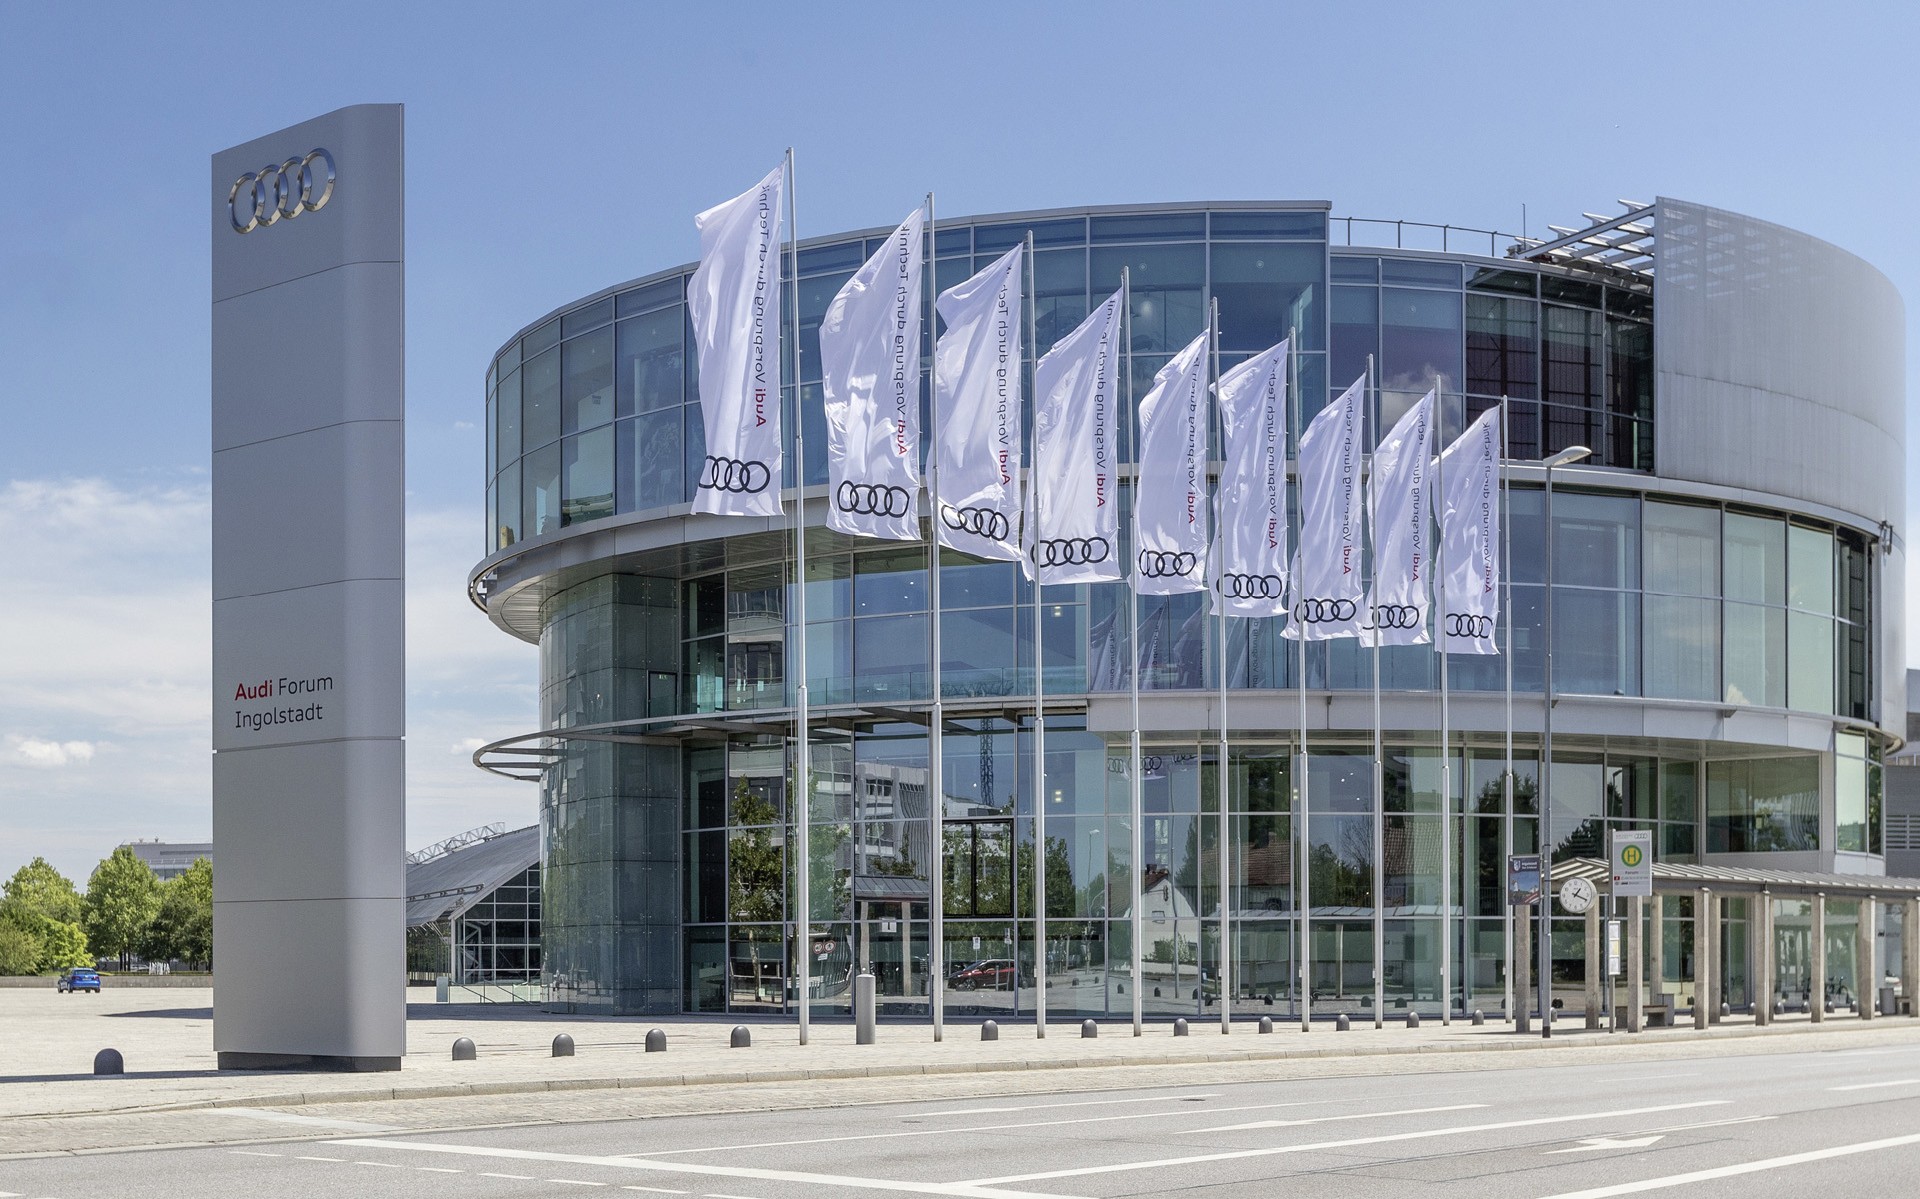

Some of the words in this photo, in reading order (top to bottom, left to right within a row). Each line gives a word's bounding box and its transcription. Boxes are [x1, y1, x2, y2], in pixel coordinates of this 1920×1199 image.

[234, 680, 273, 701] Audi
[278, 676, 333, 696] Forum
[235, 703, 323, 731] Ingolstadt
